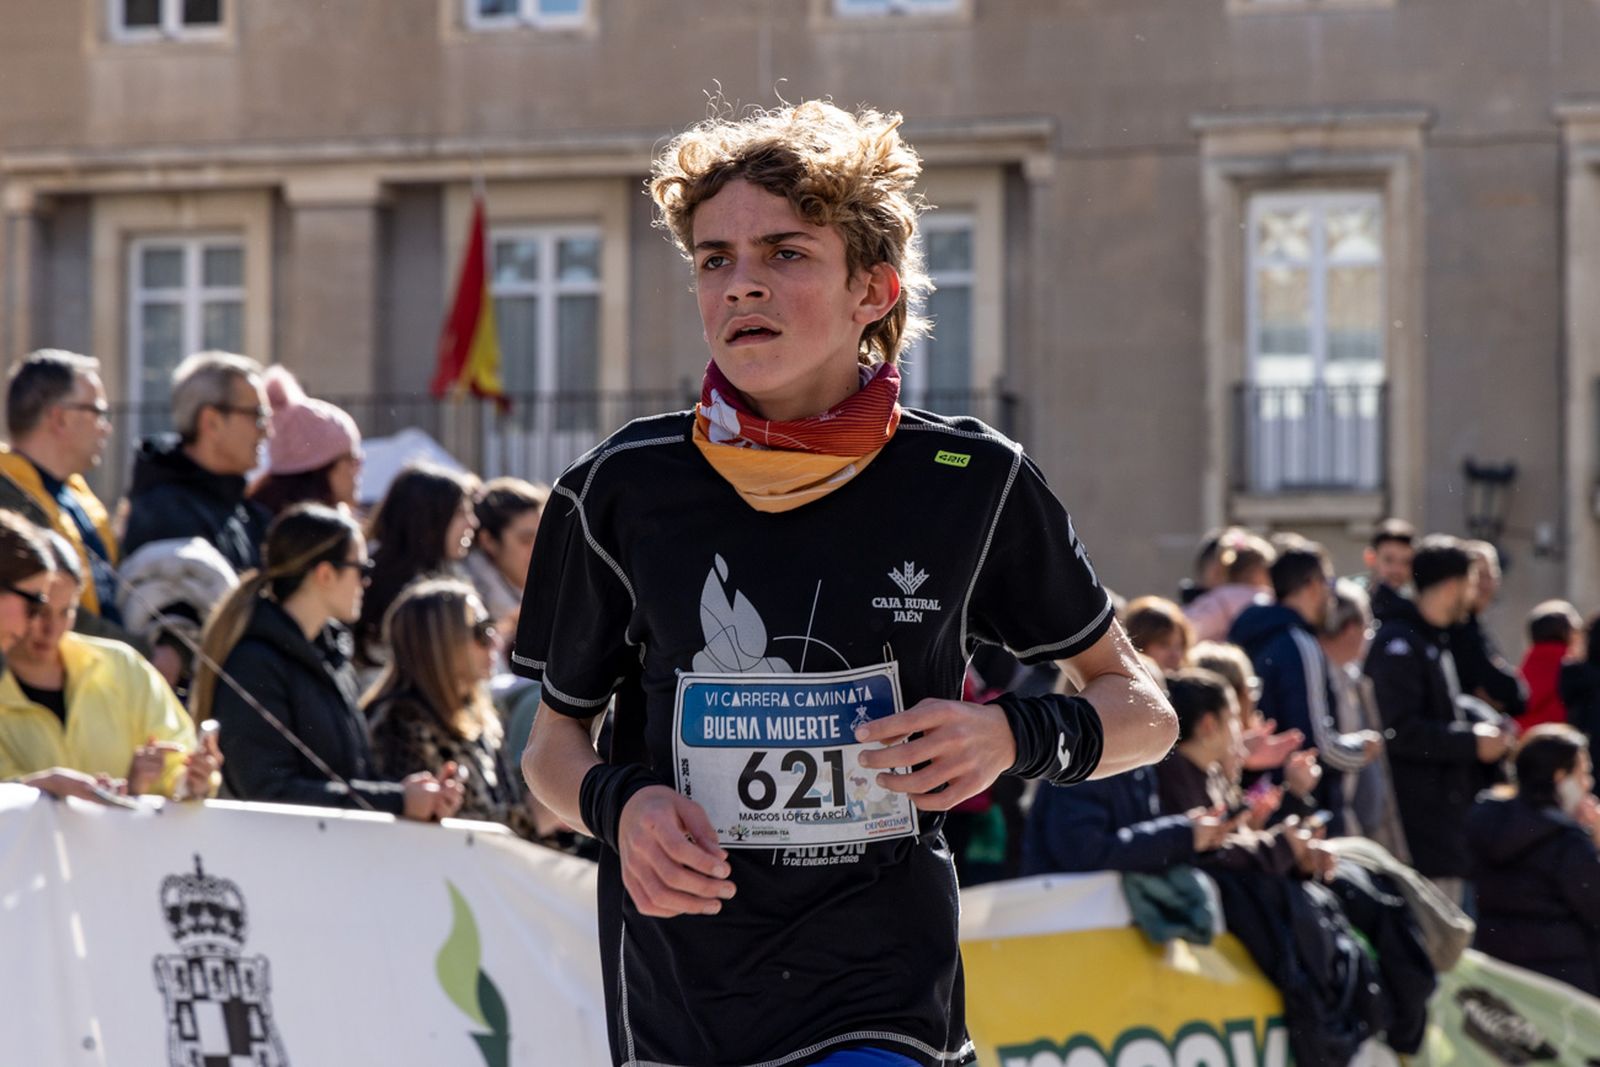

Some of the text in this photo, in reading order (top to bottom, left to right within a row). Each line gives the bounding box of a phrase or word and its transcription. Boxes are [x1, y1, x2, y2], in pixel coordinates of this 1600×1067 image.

[871, 597, 941, 611] CAJA RURAL
[893, 609, 923, 623] JAÉN
[705, 685, 873, 707] VI CARRERA CAMINATA
[703, 715, 841, 741] BUENA MUERTE
[737, 749, 846, 811] 621
[739, 809, 852, 822] MARCOS LÓPEZ GARCÍA
[782, 857, 791, 865] 17
[791, 857, 800, 866] DE
[802, 857, 829, 866] ENERO
[829, 856, 839, 865] DE
